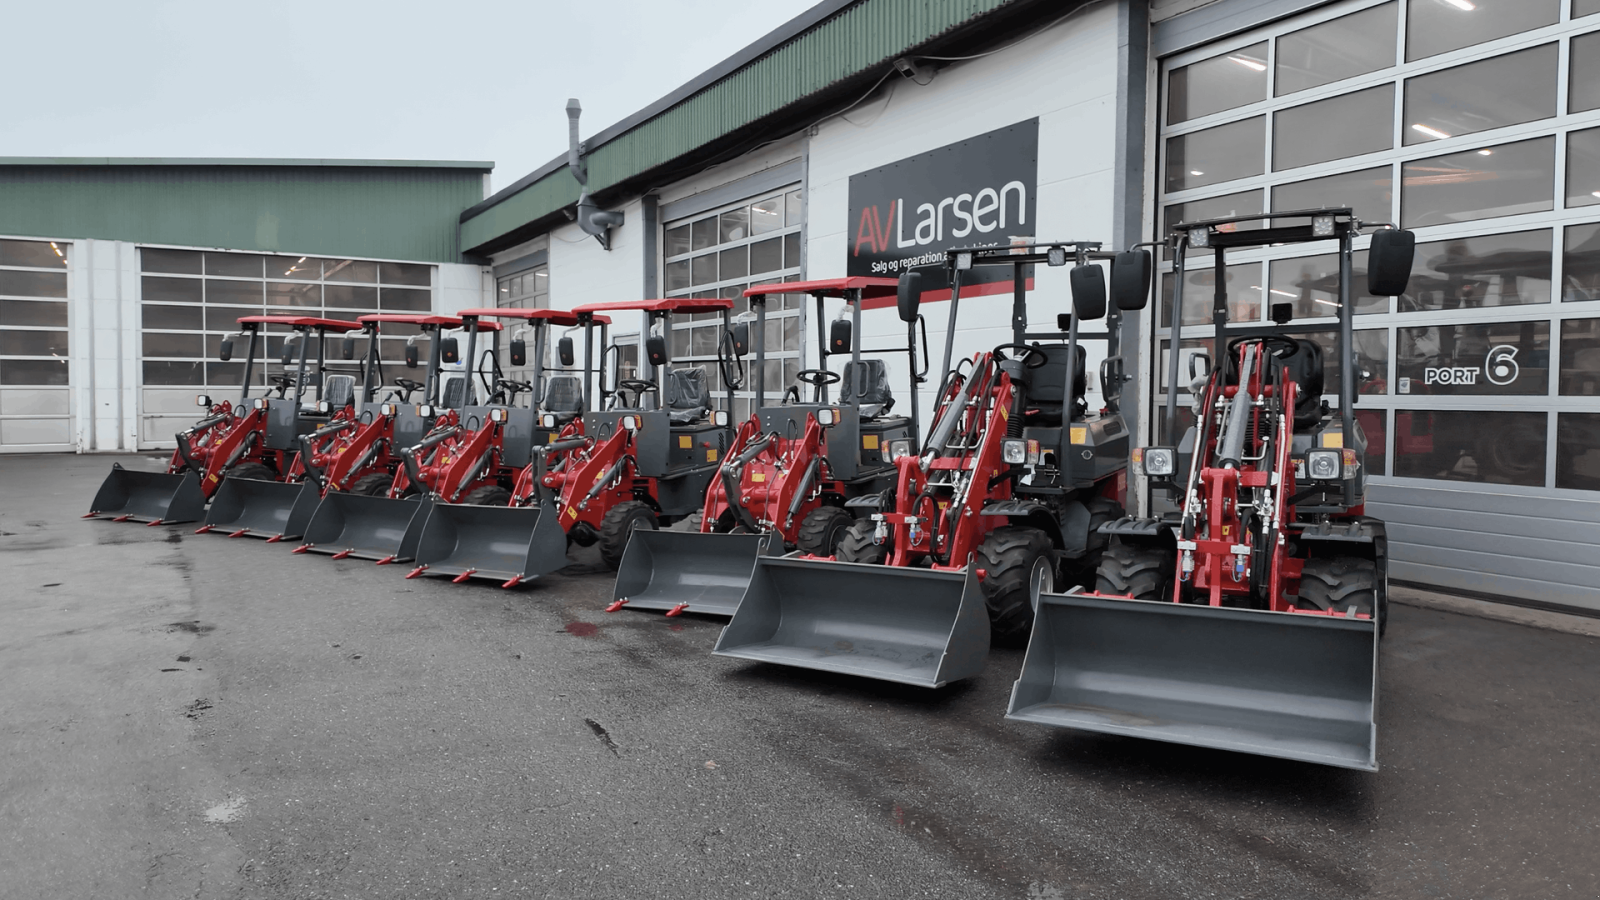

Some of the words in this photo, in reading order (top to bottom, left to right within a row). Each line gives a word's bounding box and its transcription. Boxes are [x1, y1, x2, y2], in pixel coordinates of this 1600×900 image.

[871, 260, 888, 274] Salg
[888, 261, 898, 272] og
[899, 252, 941, 268] reparation
[1425, 367, 1480, 385] PORT
[1485, 344, 1519, 385] 6
